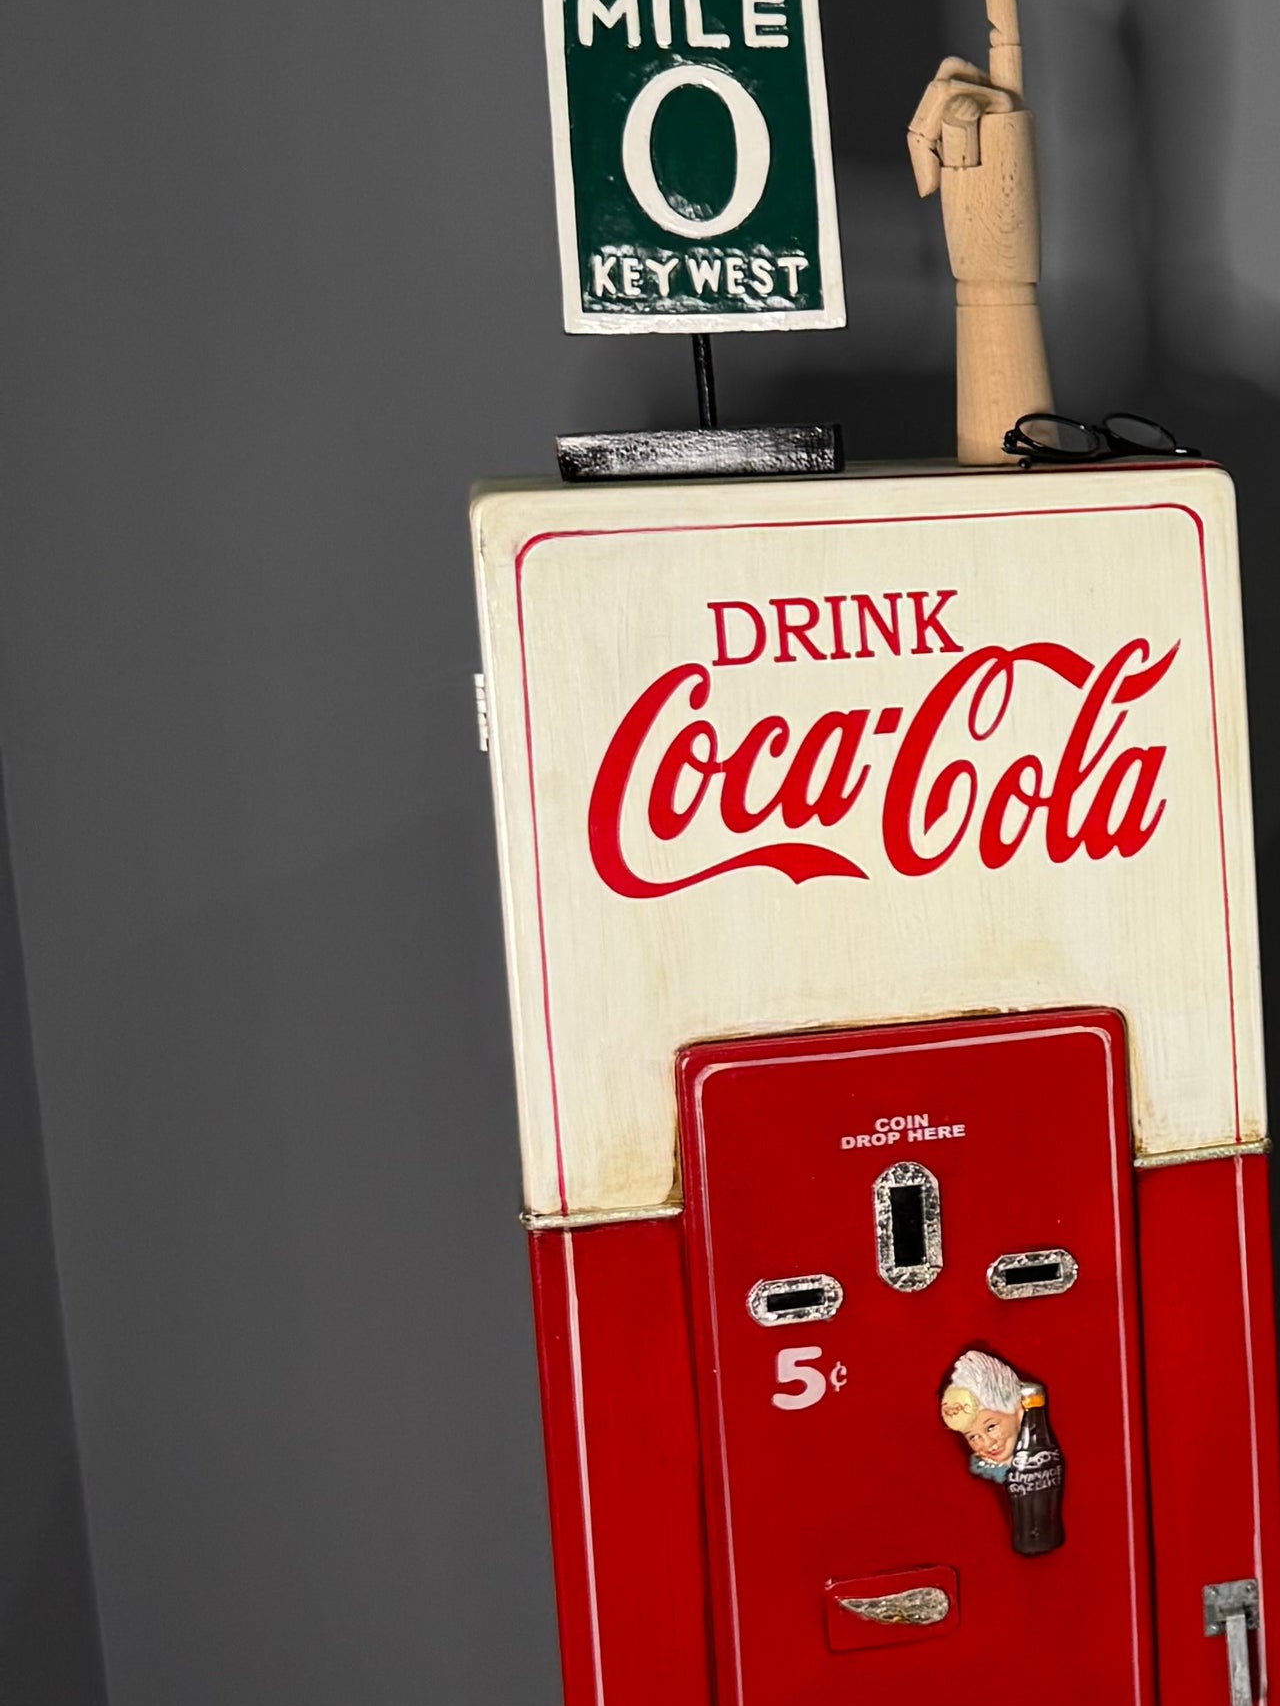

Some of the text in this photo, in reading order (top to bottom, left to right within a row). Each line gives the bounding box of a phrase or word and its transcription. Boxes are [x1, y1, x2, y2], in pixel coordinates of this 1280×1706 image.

[592, 254, 809, 297] KEY WEST
[707, 590, 965, 666] DRINK
[588, 638, 1181, 899] Coca-Cola
[840, 1124, 966, 1150] DROP HERE
[874, 1113, 929, 1133] COIN
